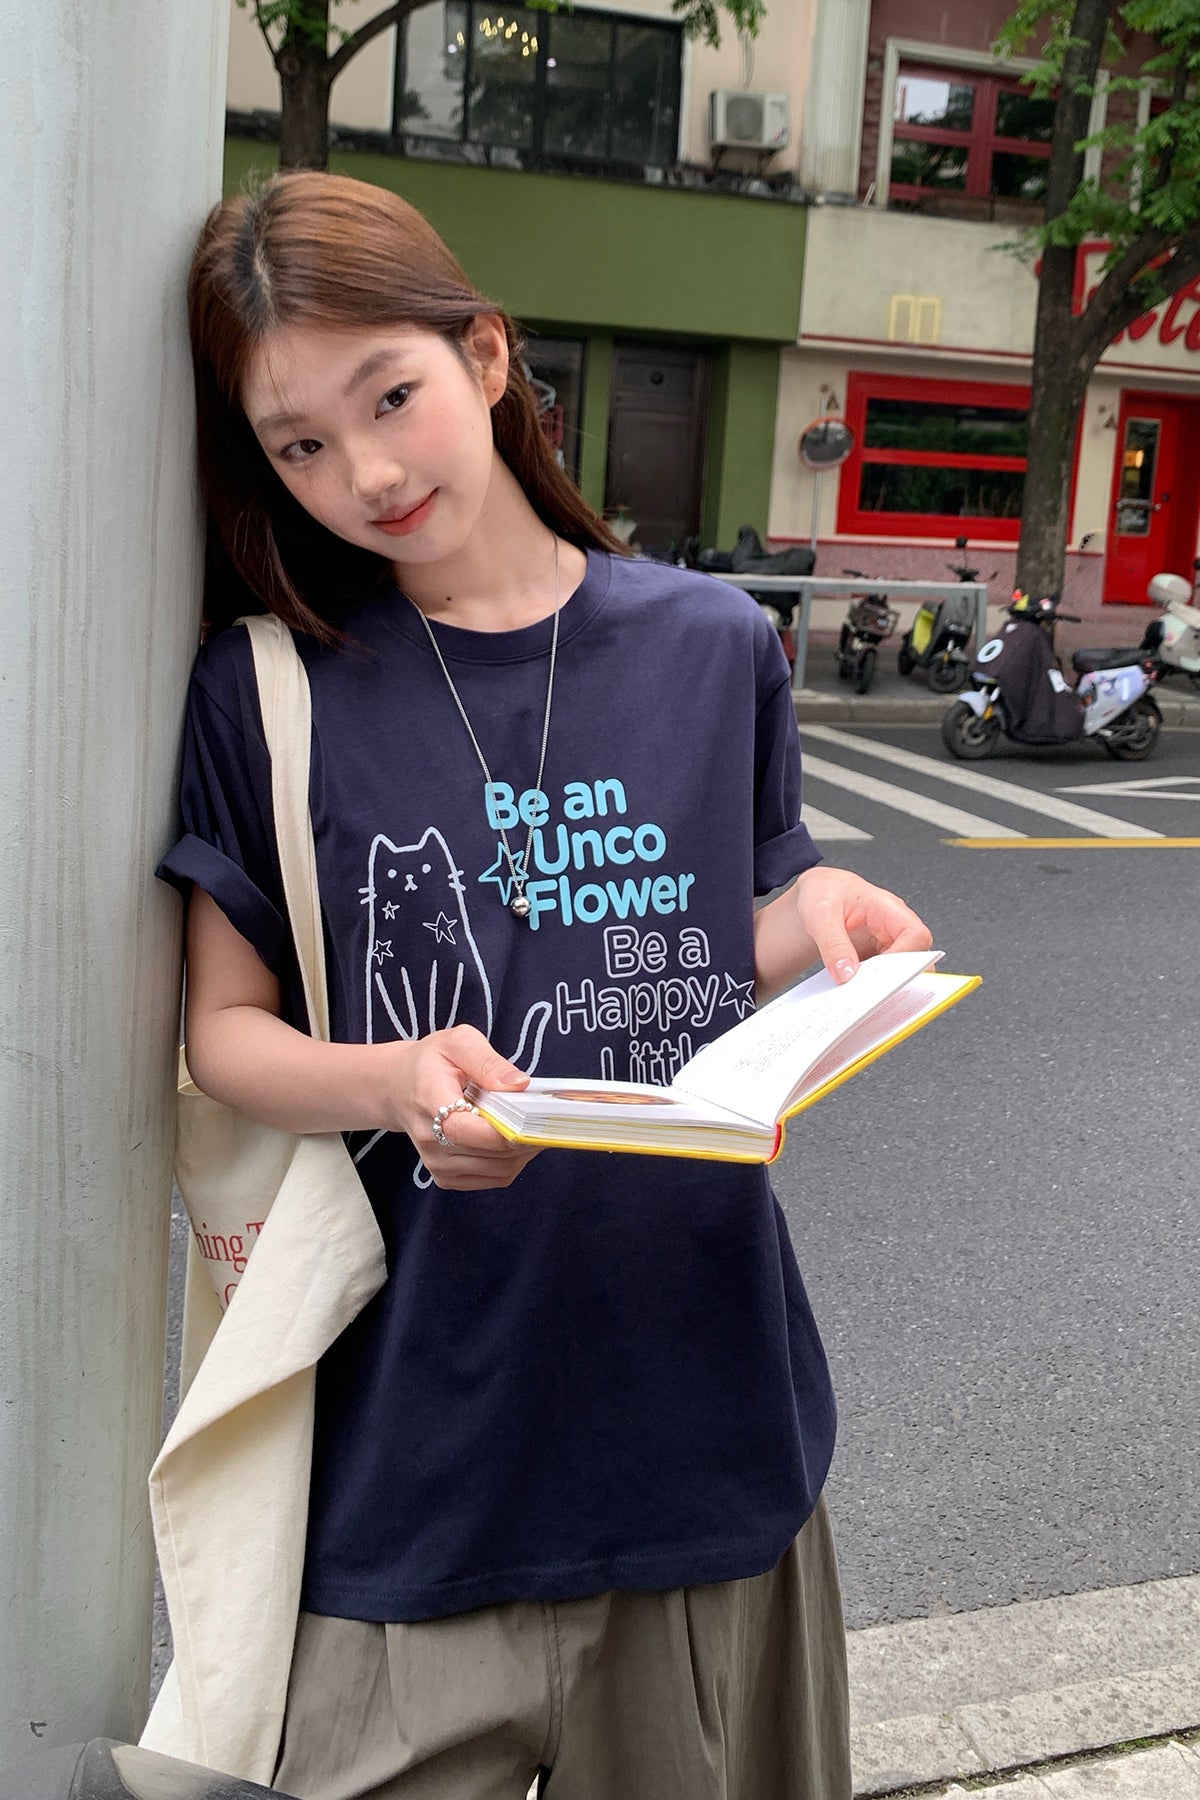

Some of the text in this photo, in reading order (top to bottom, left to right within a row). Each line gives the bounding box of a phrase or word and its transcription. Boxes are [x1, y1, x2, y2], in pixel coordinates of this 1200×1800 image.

[484, 778, 627, 830] Be an
[533, 823, 667, 875] Unco
[527, 872, 695, 931] Flower
[602, 925, 711, 979] Be a
[556, 974, 720, 1035] Happy
[600, 1032, 711, 1087] Littl
